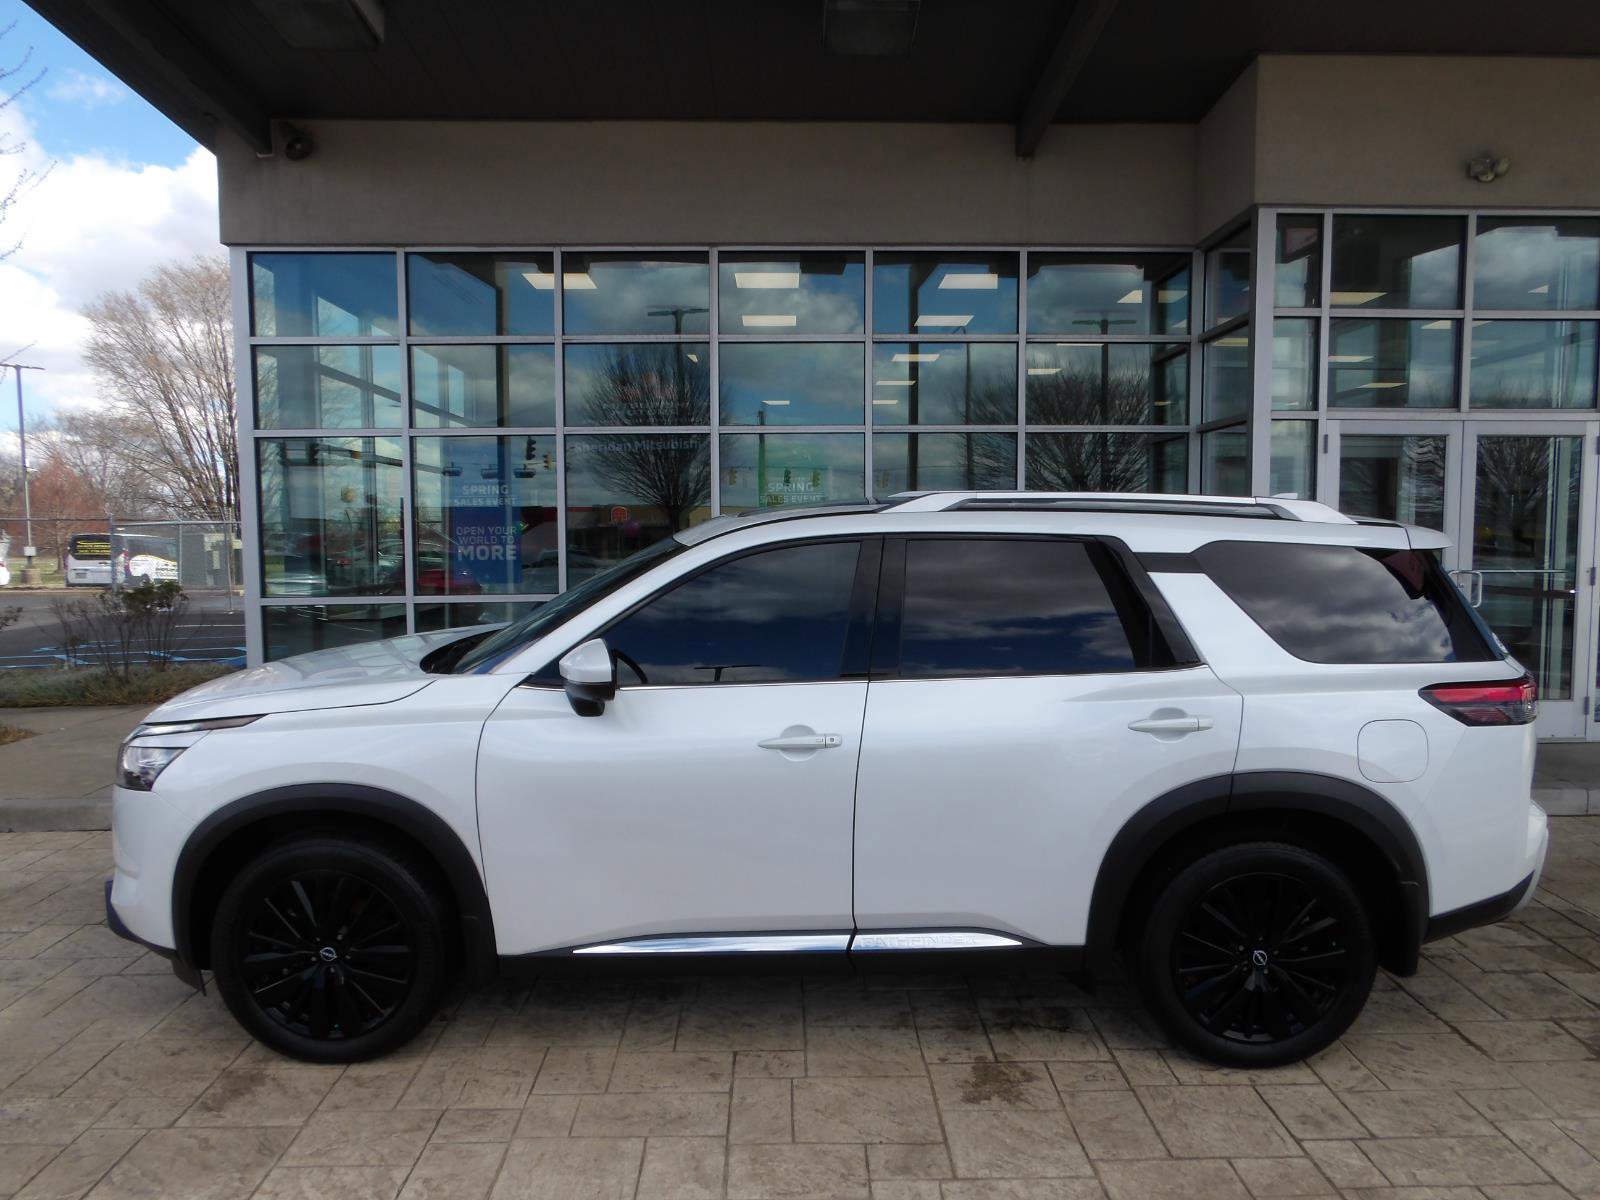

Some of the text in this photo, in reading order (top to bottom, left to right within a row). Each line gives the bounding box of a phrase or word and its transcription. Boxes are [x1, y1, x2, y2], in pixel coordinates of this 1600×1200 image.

[462, 484, 510, 495] SPRING
[768, 482, 814, 493] SPRING
[454, 497, 517, 506] SALES EVENT
[760, 494, 821, 504] SALES EVENT
[456, 526, 518, 536] OPEN YOUR
[457, 535, 515, 545] WORLD TO
[457, 545, 517, 561] MORE
